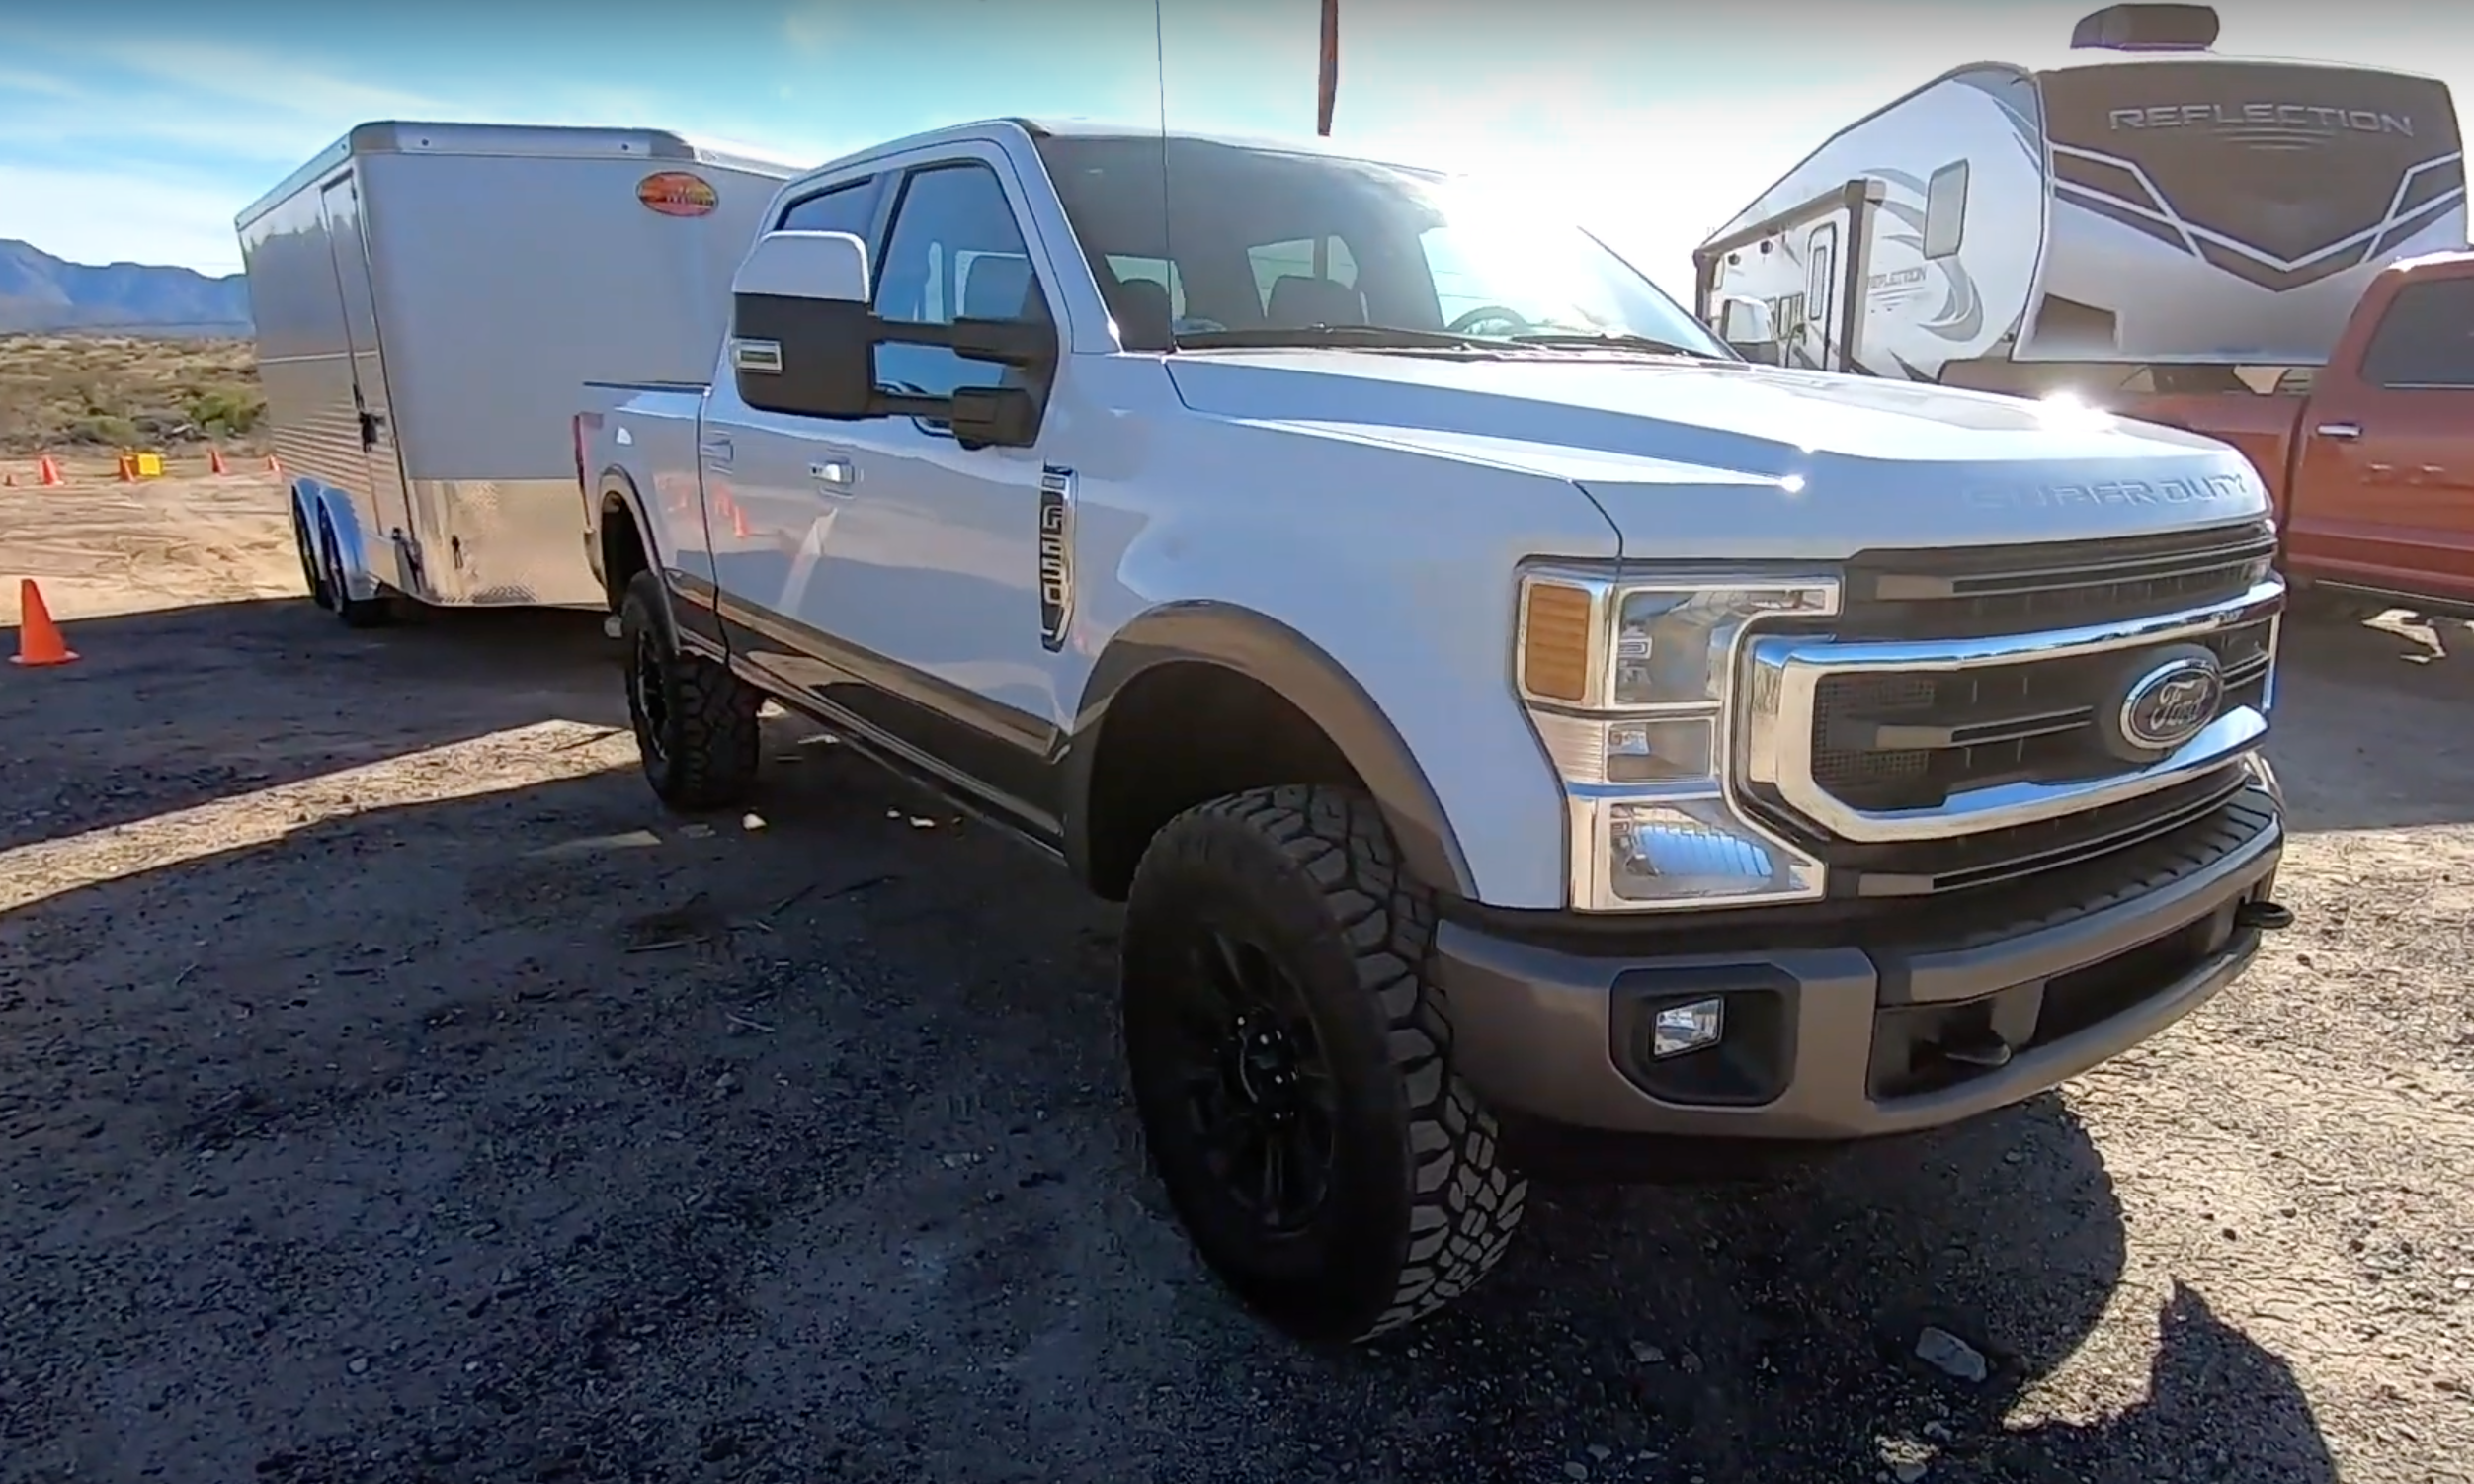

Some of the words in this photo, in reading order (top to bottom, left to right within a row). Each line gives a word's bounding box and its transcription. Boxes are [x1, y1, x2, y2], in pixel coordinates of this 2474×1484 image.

[2108, 104, 2413, 137] REFLECTION
[1961, 478, 2158, 508] SUPER
[2159, 473, 2247, 503] DUTY
[2149, 677, 2209, 731] Ford
